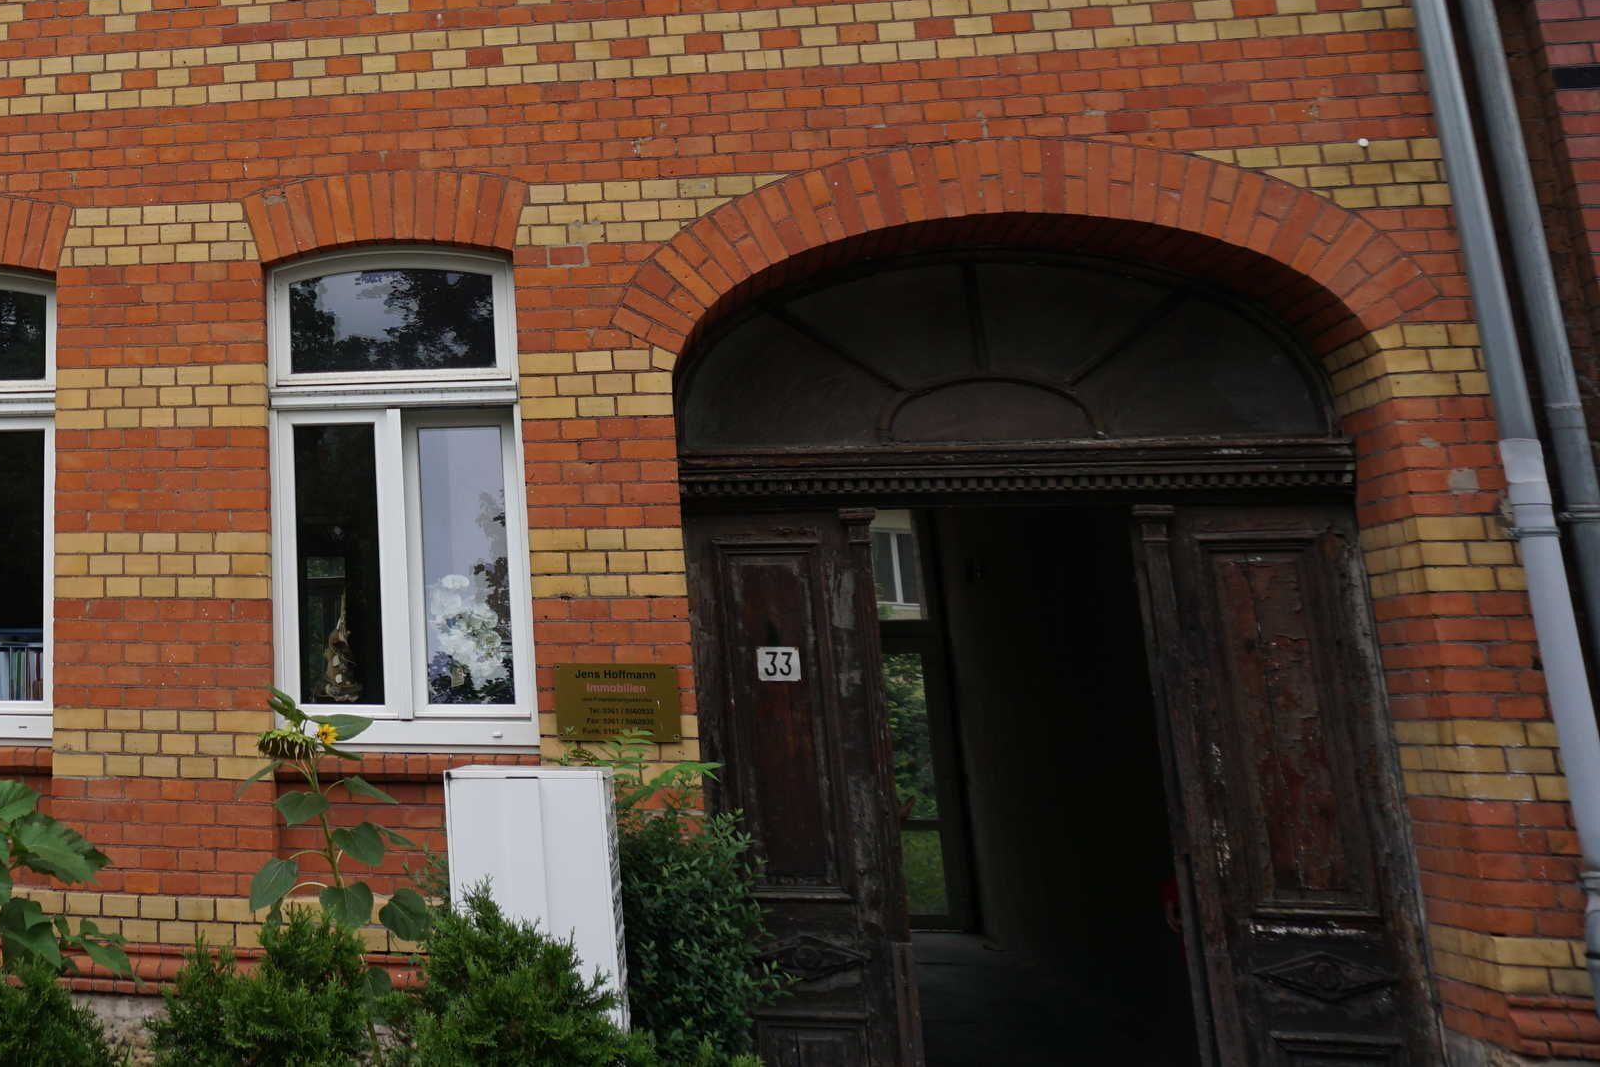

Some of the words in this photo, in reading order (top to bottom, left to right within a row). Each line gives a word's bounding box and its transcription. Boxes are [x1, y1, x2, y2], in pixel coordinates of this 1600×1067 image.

[764, 651, 793, 677] 33
[575, 669, 600, 679] Jens
[604, 669, 656, 680] Hoffmann
[586, 682, 647, 694] Immobilien
